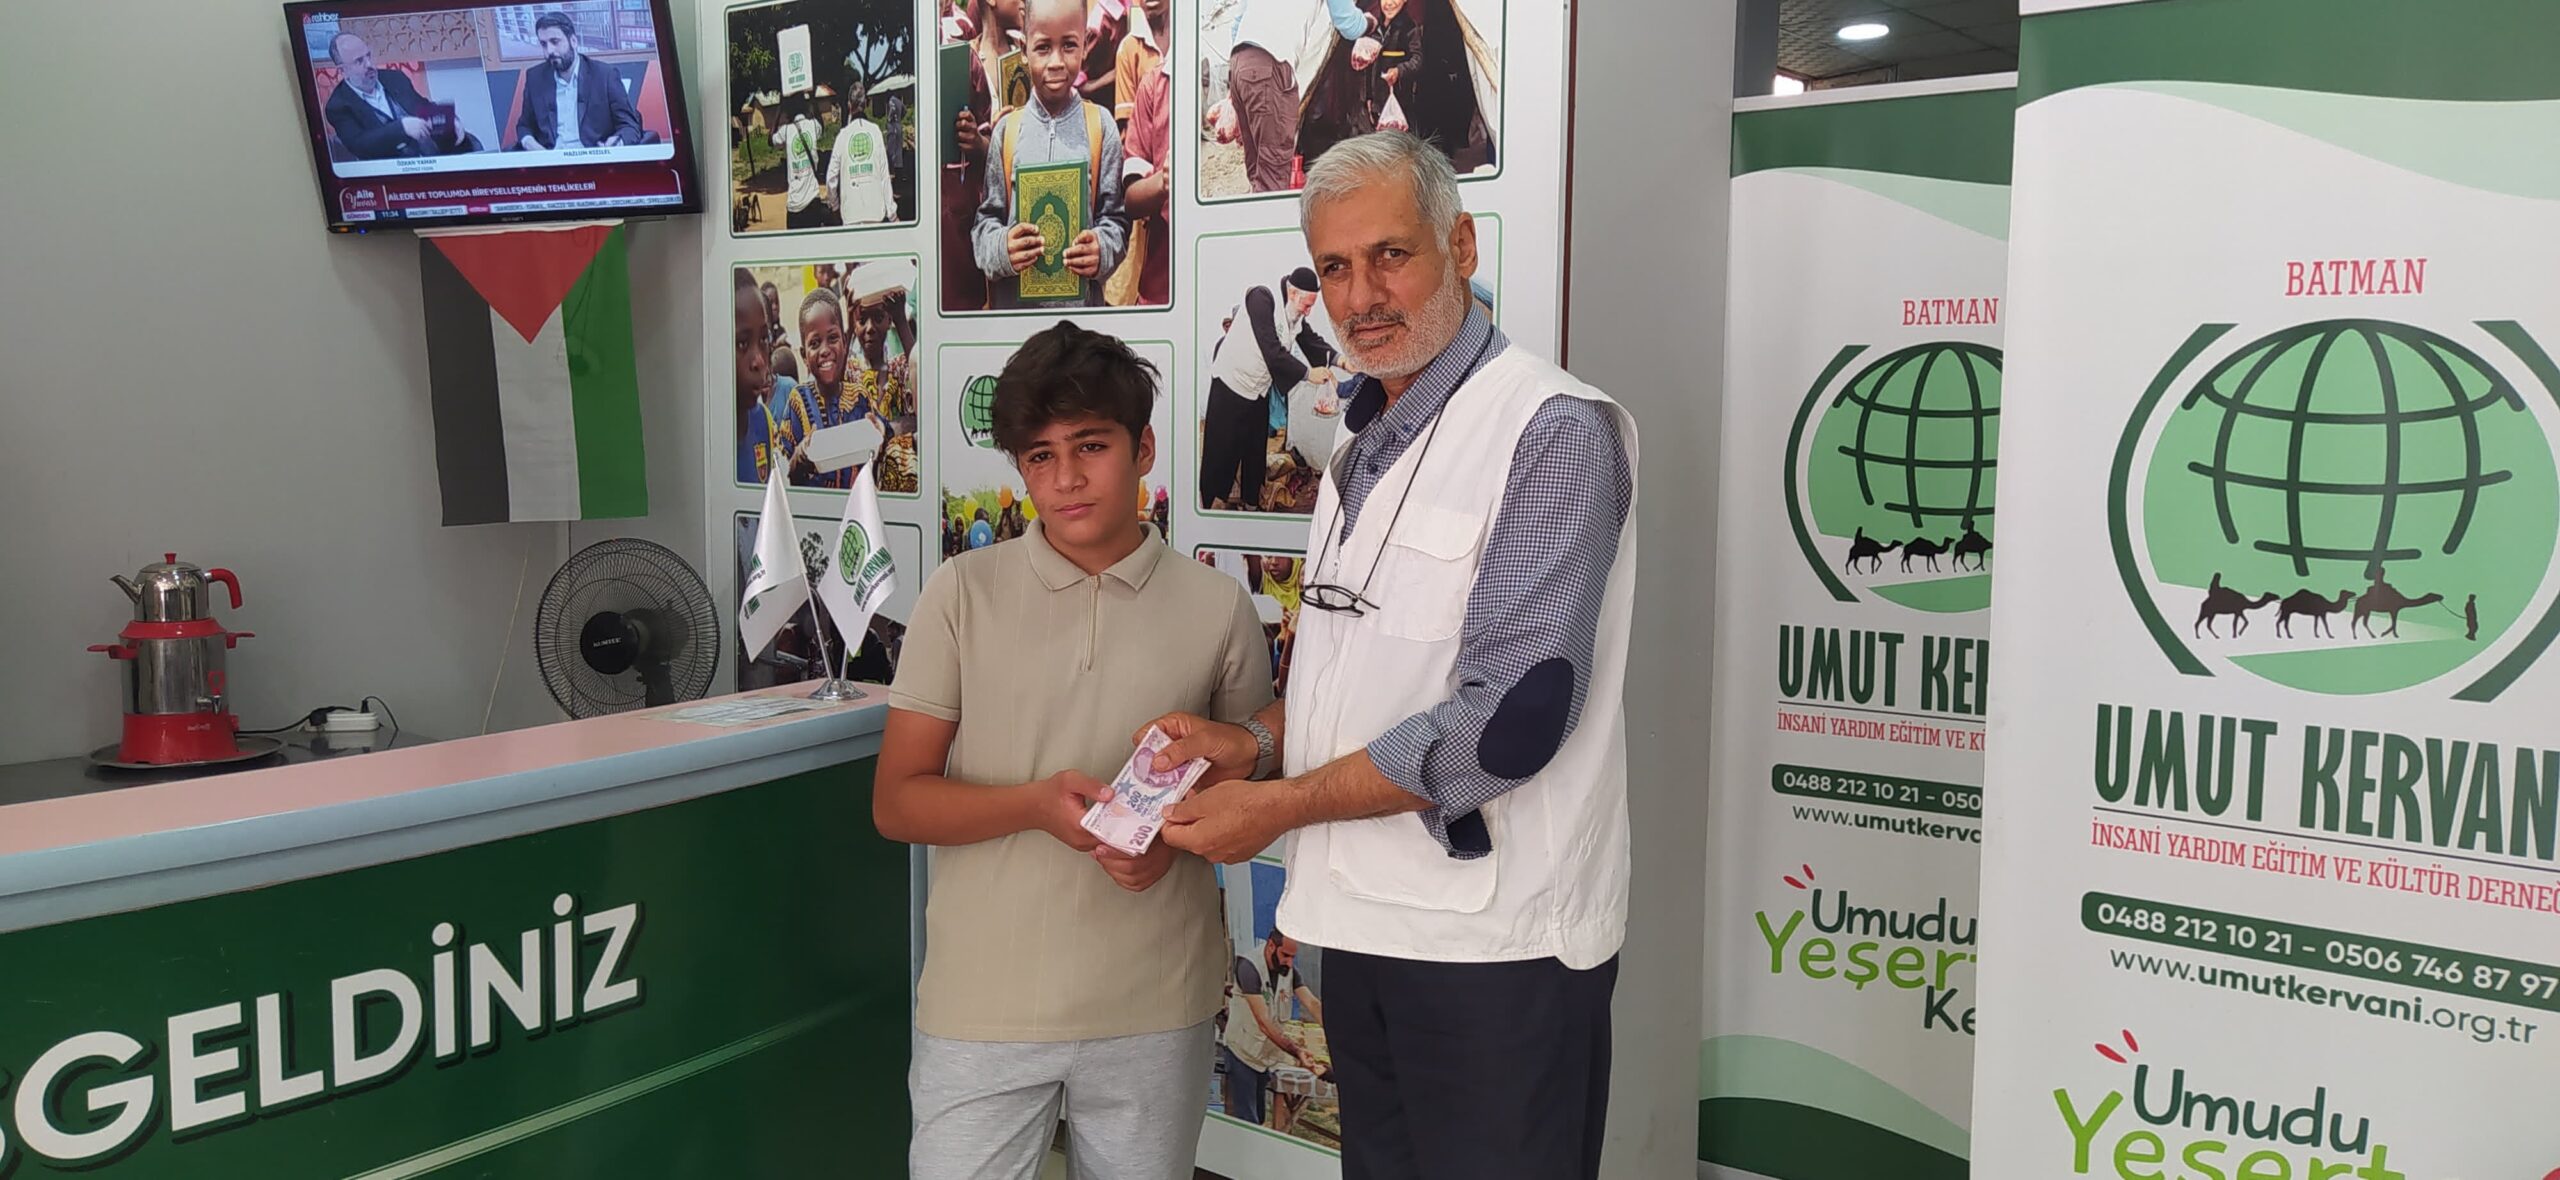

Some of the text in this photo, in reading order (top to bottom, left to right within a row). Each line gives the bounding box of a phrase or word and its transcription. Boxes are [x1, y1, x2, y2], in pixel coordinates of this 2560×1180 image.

[388, 192, 415, 201] AİLEDE
[416, 191, 427, 200] VE
[428, 188, 471, 199] TOPLUMDA
[548, 181, 596, 192] TEHLİKELERİ
[1902, 297, 1999, 326] BATMAN
[2285, 258, 2427, 296] BATMAN
[1778, 624, 1904, 707] UMUT
[1777, 708, 1826, 735] İNSANİ
[1830, 717, 1885, 741] YARDIM
[1889, 720, 1941, 747] EĞİTİM
[1945, 730, 1966, 749] VE
[1127, 790, 1141, 808] 200
[1783, 771, 1832, 792] 0488
[1836, 777, 1867, 797] 212
[1872, 782, 1894, 800] 10
[1900, 785, 1919, 803] 21
[1942, 791, 1982, 811] 050
[2094, 703, 2560, 861] UMUT KERVAN
[1129, 825, 1153, 846] 200
[2091, 816, 2161, 855] İNSANİ
[2166, 833, 2246, 868] YARDIM
[2252, 840, 2327, 880] EĞİTİM
[2333, 856, 2362, 884] VE
[2366, 857, 2461, 899] KÜLTÜR
[1755, 910, 1976, 991] Yeşer
[1811, 888, 1976, 946] Umudu
[2098, 902, 2166, 934] 0488
[2174, 914, 2218, 943] 212
[2226, 923, 2257, 948] 10
[2264, 930, 2293, 955] 21
[2325, 940, 2402, 973] 0506
[2411, 954, 2464, 984] 746
[2473, 965, 2511, 992] 87
[2519, 973, 2559, 1000] 97
[0, 893, 638, 1164] GELDİNİZ
[2110, 949, 2537, 1043] www.umutkervani.org.tr
[2133, 1064, 2369, 1154] Umudu
